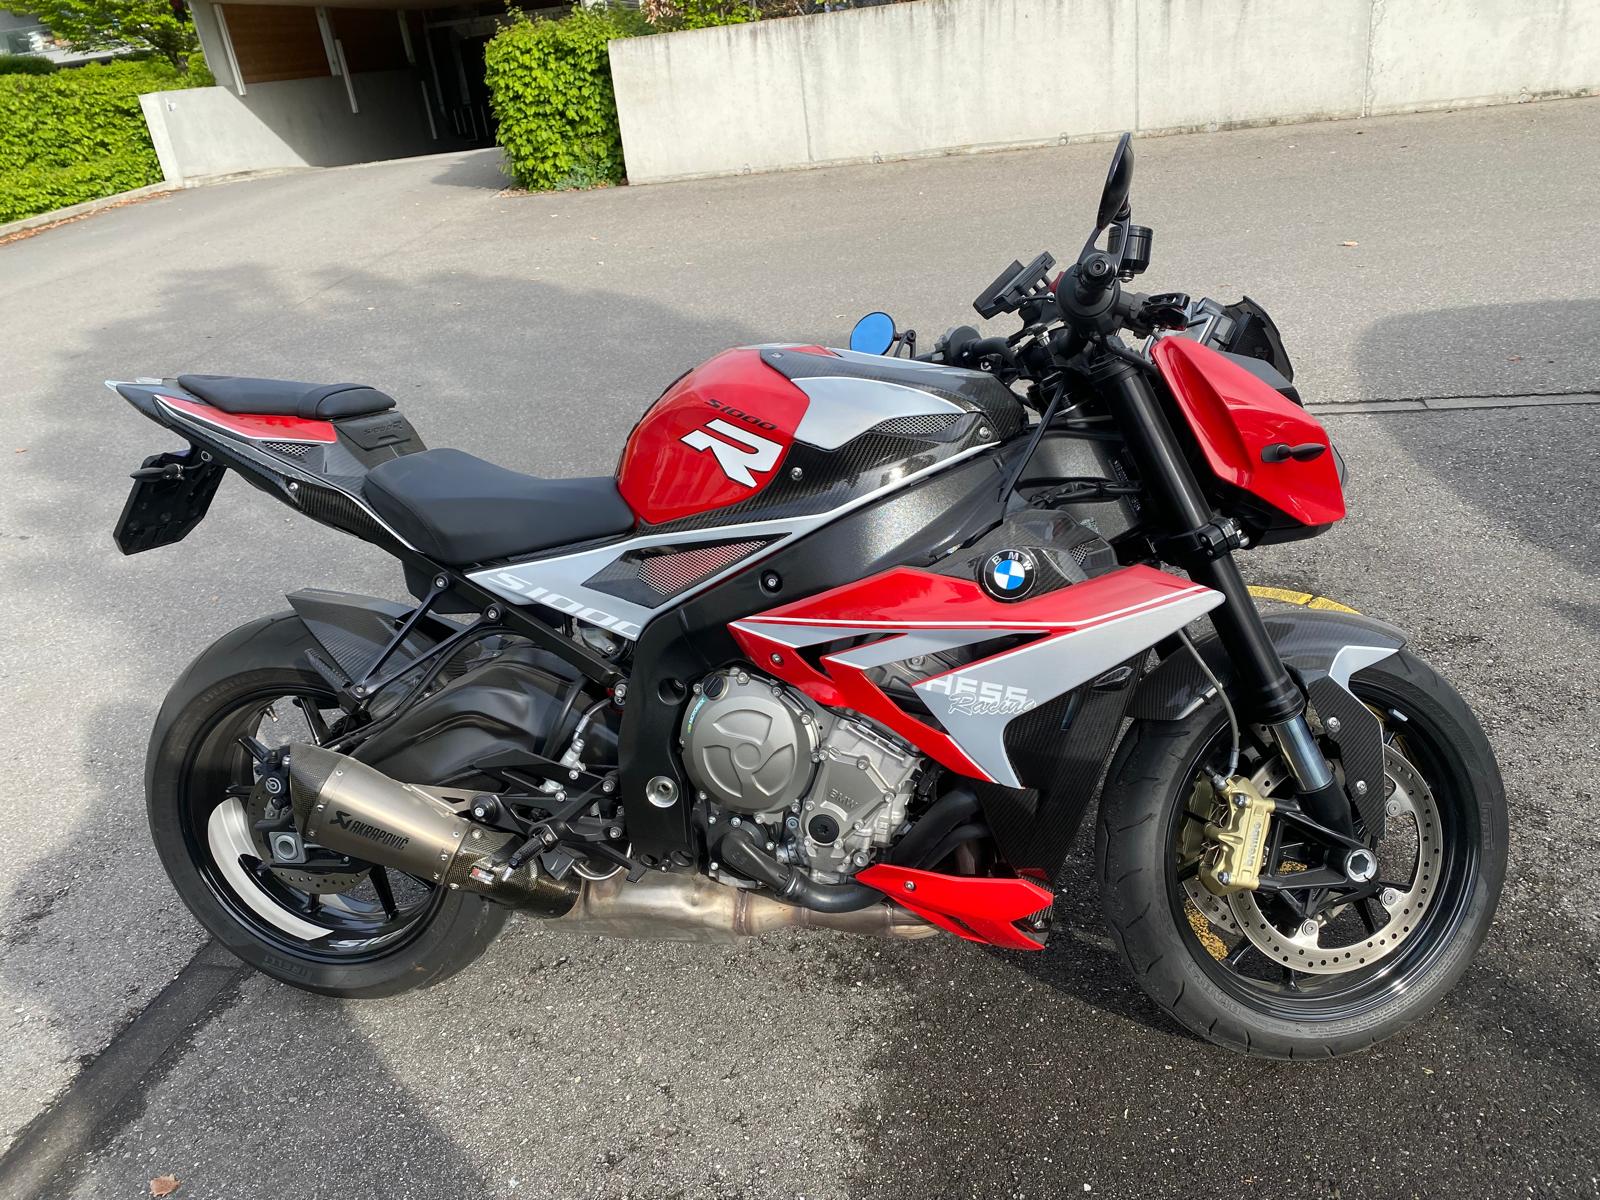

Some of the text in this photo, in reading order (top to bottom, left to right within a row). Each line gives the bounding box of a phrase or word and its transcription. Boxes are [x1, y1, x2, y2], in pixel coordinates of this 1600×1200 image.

[704, 398, 777, 431] S1000
[679, 417, 784, 488] R
[991, 551, 1033, 571] BMW
[349, 820, 410, 850] AKRAPOVIČ
